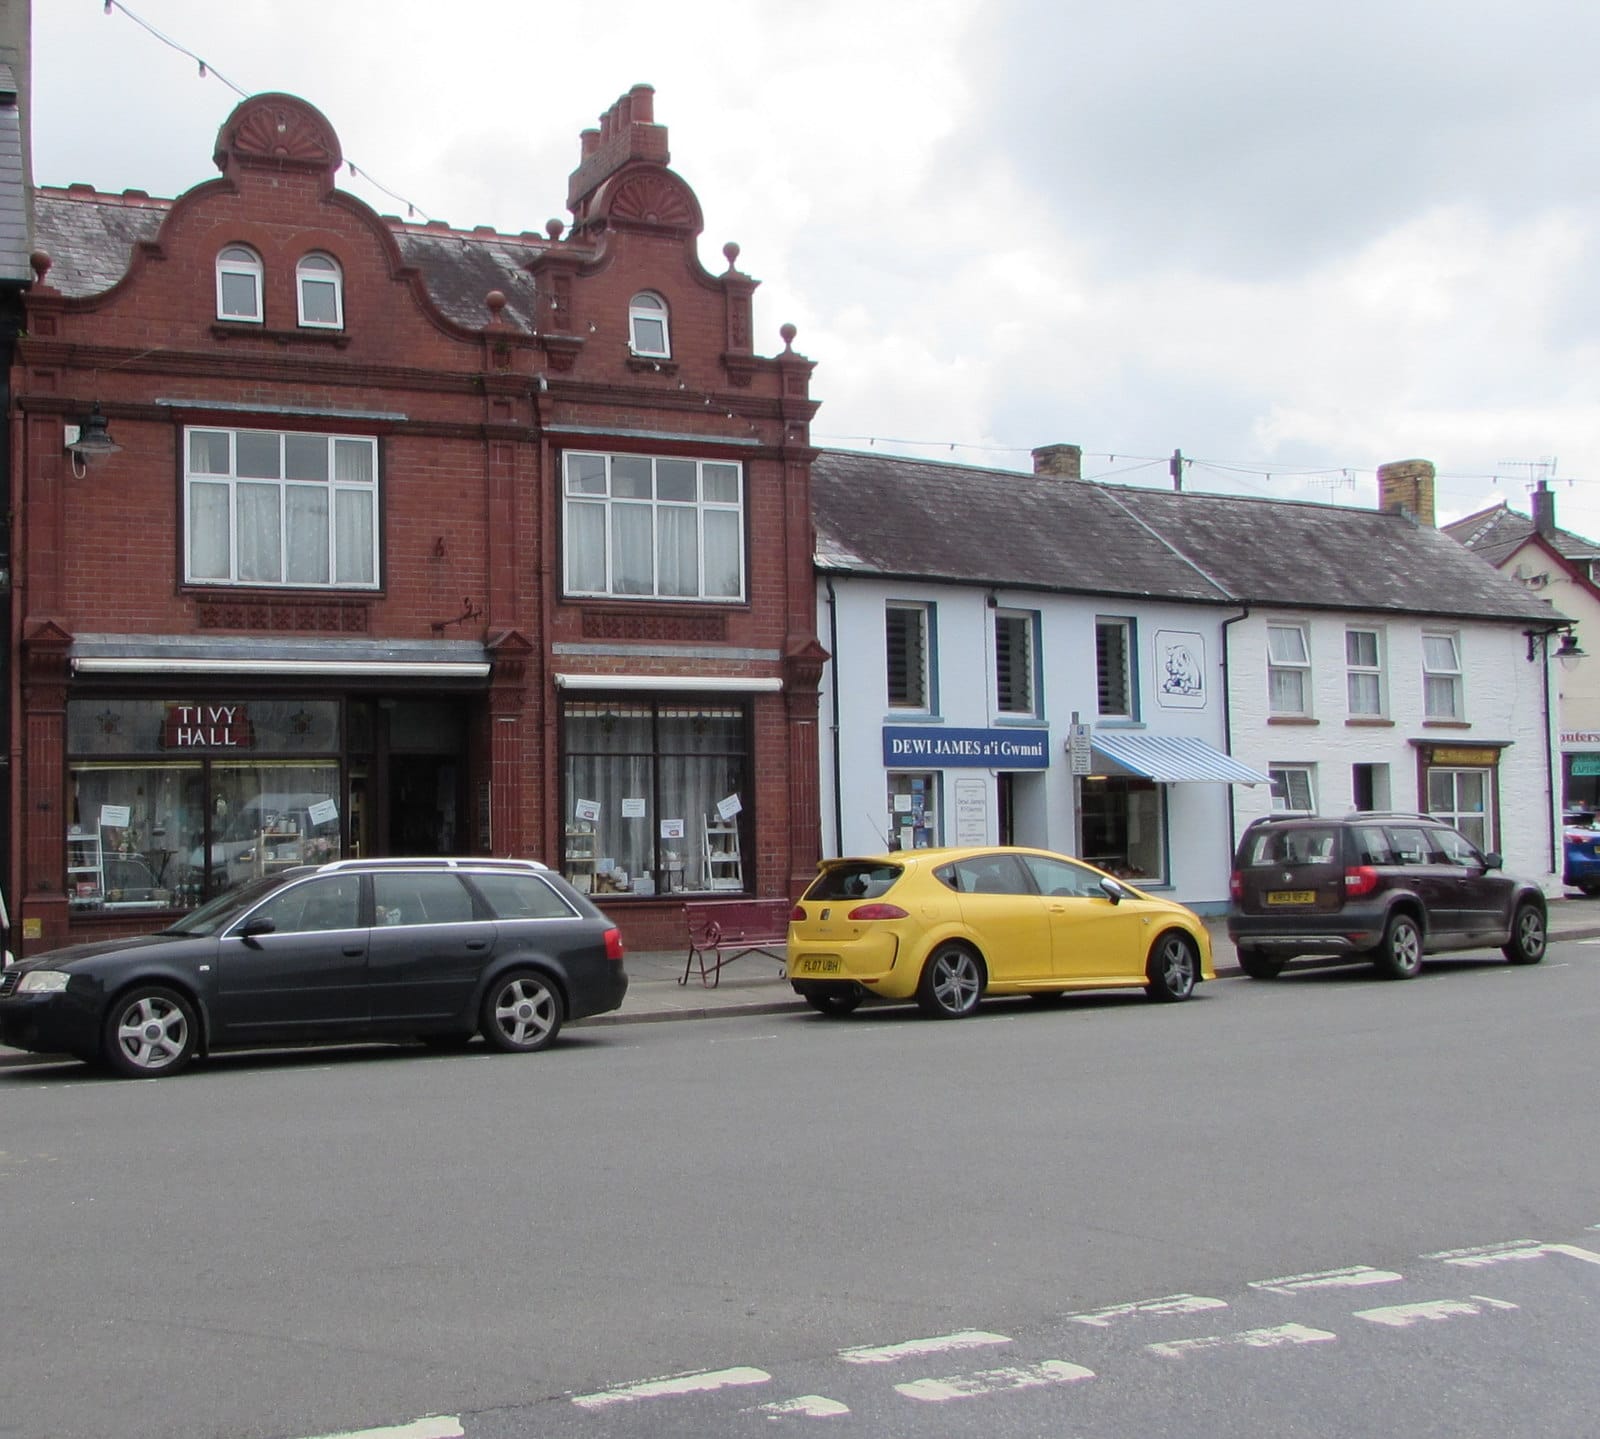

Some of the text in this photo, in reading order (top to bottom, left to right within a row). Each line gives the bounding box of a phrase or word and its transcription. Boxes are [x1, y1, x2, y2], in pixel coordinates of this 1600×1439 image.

[177, 706, 236, 724] TIVY
[177, 727, 237, 746] HALL
[892, 738, 1042, 757] DEWI JAMES a'i Gwmni
